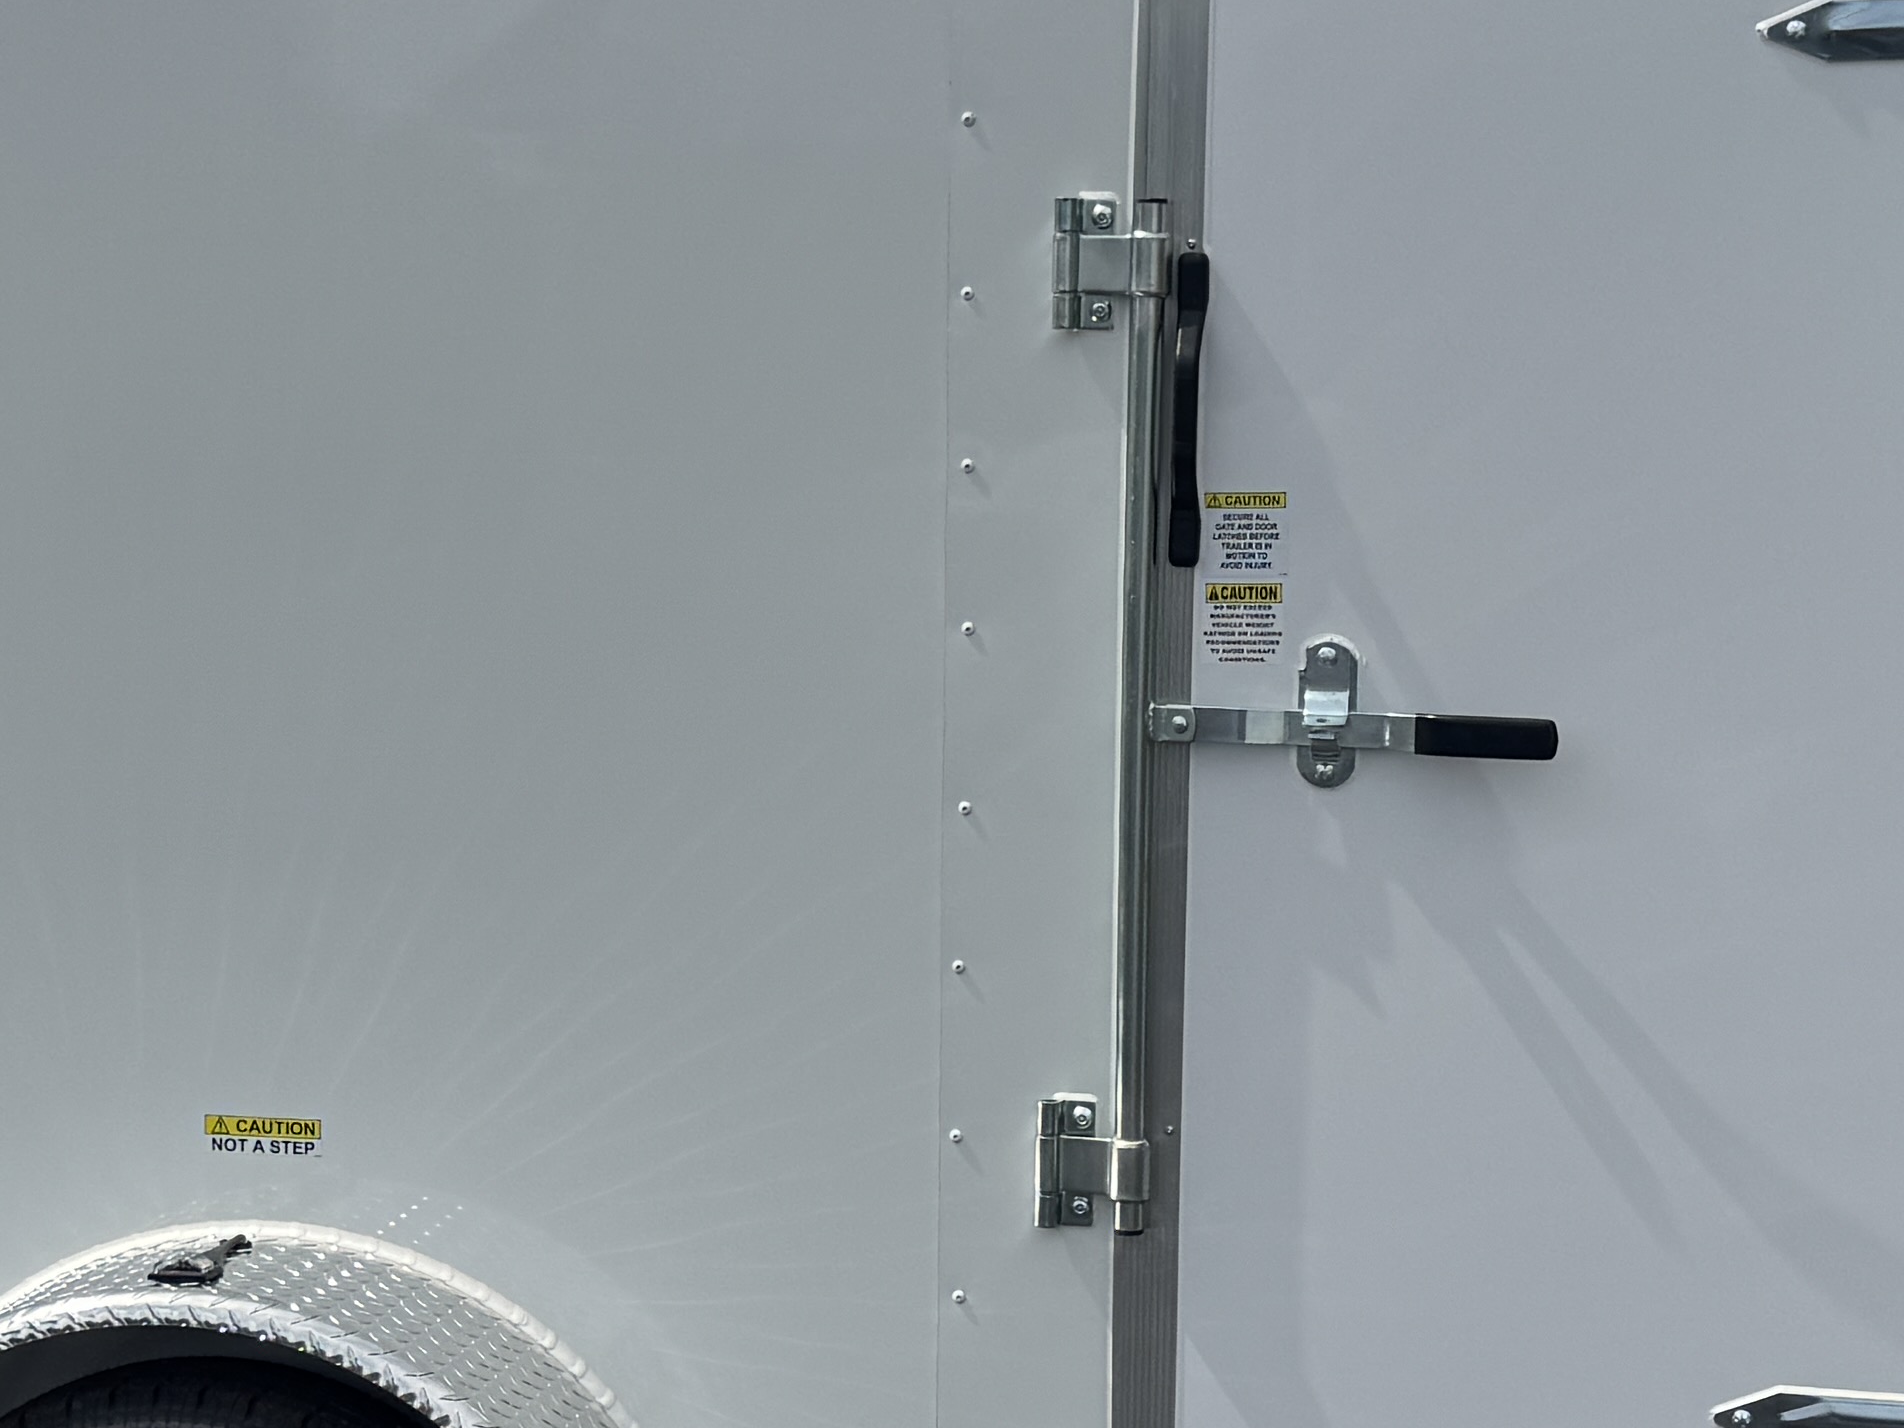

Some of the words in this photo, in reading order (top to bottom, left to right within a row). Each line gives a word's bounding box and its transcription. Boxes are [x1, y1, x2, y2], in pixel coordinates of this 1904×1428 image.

[1224, 495, 1281, 506] CAUTION
[1236, 523, 1253, 531] AND
[1255, 523, 1278, 531] DOOR
[1249, 532, 1280, 540] BEFORE
[1221, 542, 1254, 550] TRAILER
[1257, 552, 1268, 560] TO
[1220, 586, 1278, 600] CAUTION
[236, 1119, 316, 1136] CAUTION
[211, 1137, 249, 1152] NOT
[252, 1139, 265, 1154] A
[269, 1139, 316, 1156] STEP
